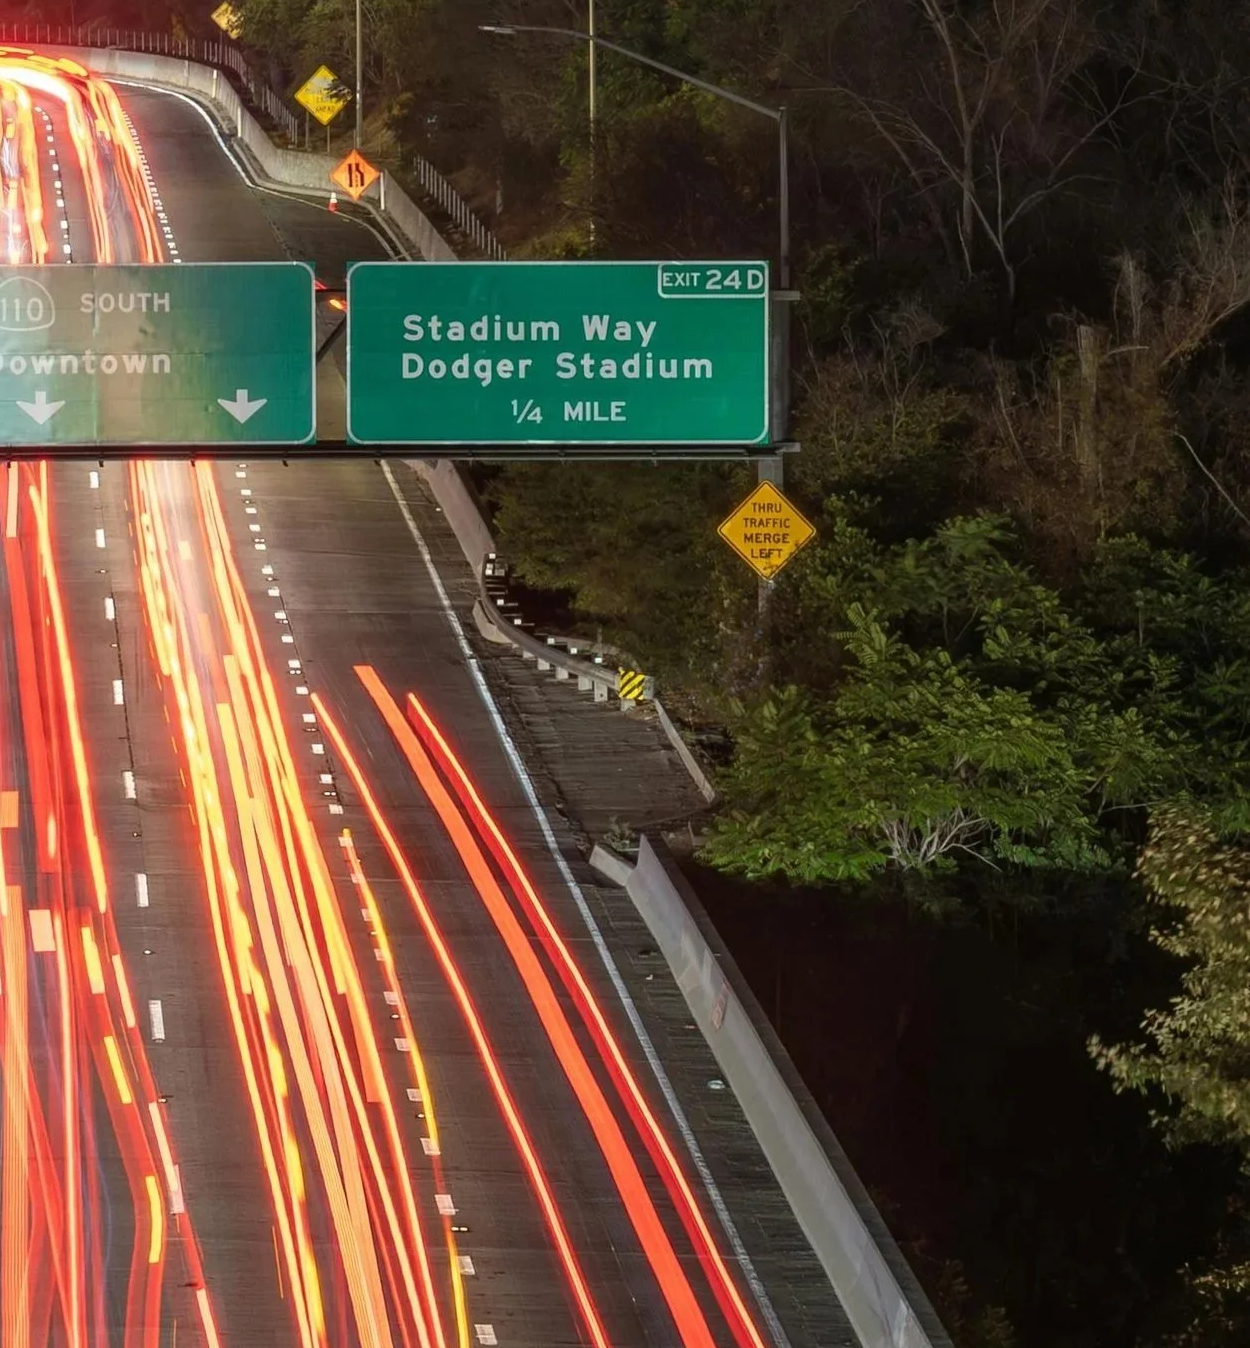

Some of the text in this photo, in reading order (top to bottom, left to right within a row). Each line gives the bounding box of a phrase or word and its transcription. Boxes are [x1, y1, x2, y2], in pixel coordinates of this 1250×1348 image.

[662, 272, 701, 287] EXIT
[0, 292, 171, 322] 110 SOUTH
[403, 314, 657, 347] Stadium Way
[401, 352, 713, 387] Dodger Stadium
[564, 402, 627, 422] MILE
[751, 502, 782, 513] THRU
[743, 517, 790, 528] TRAFFIC
[743, 533, 790, 544] MERGE
[751, 548, 783, 559] LEFT
